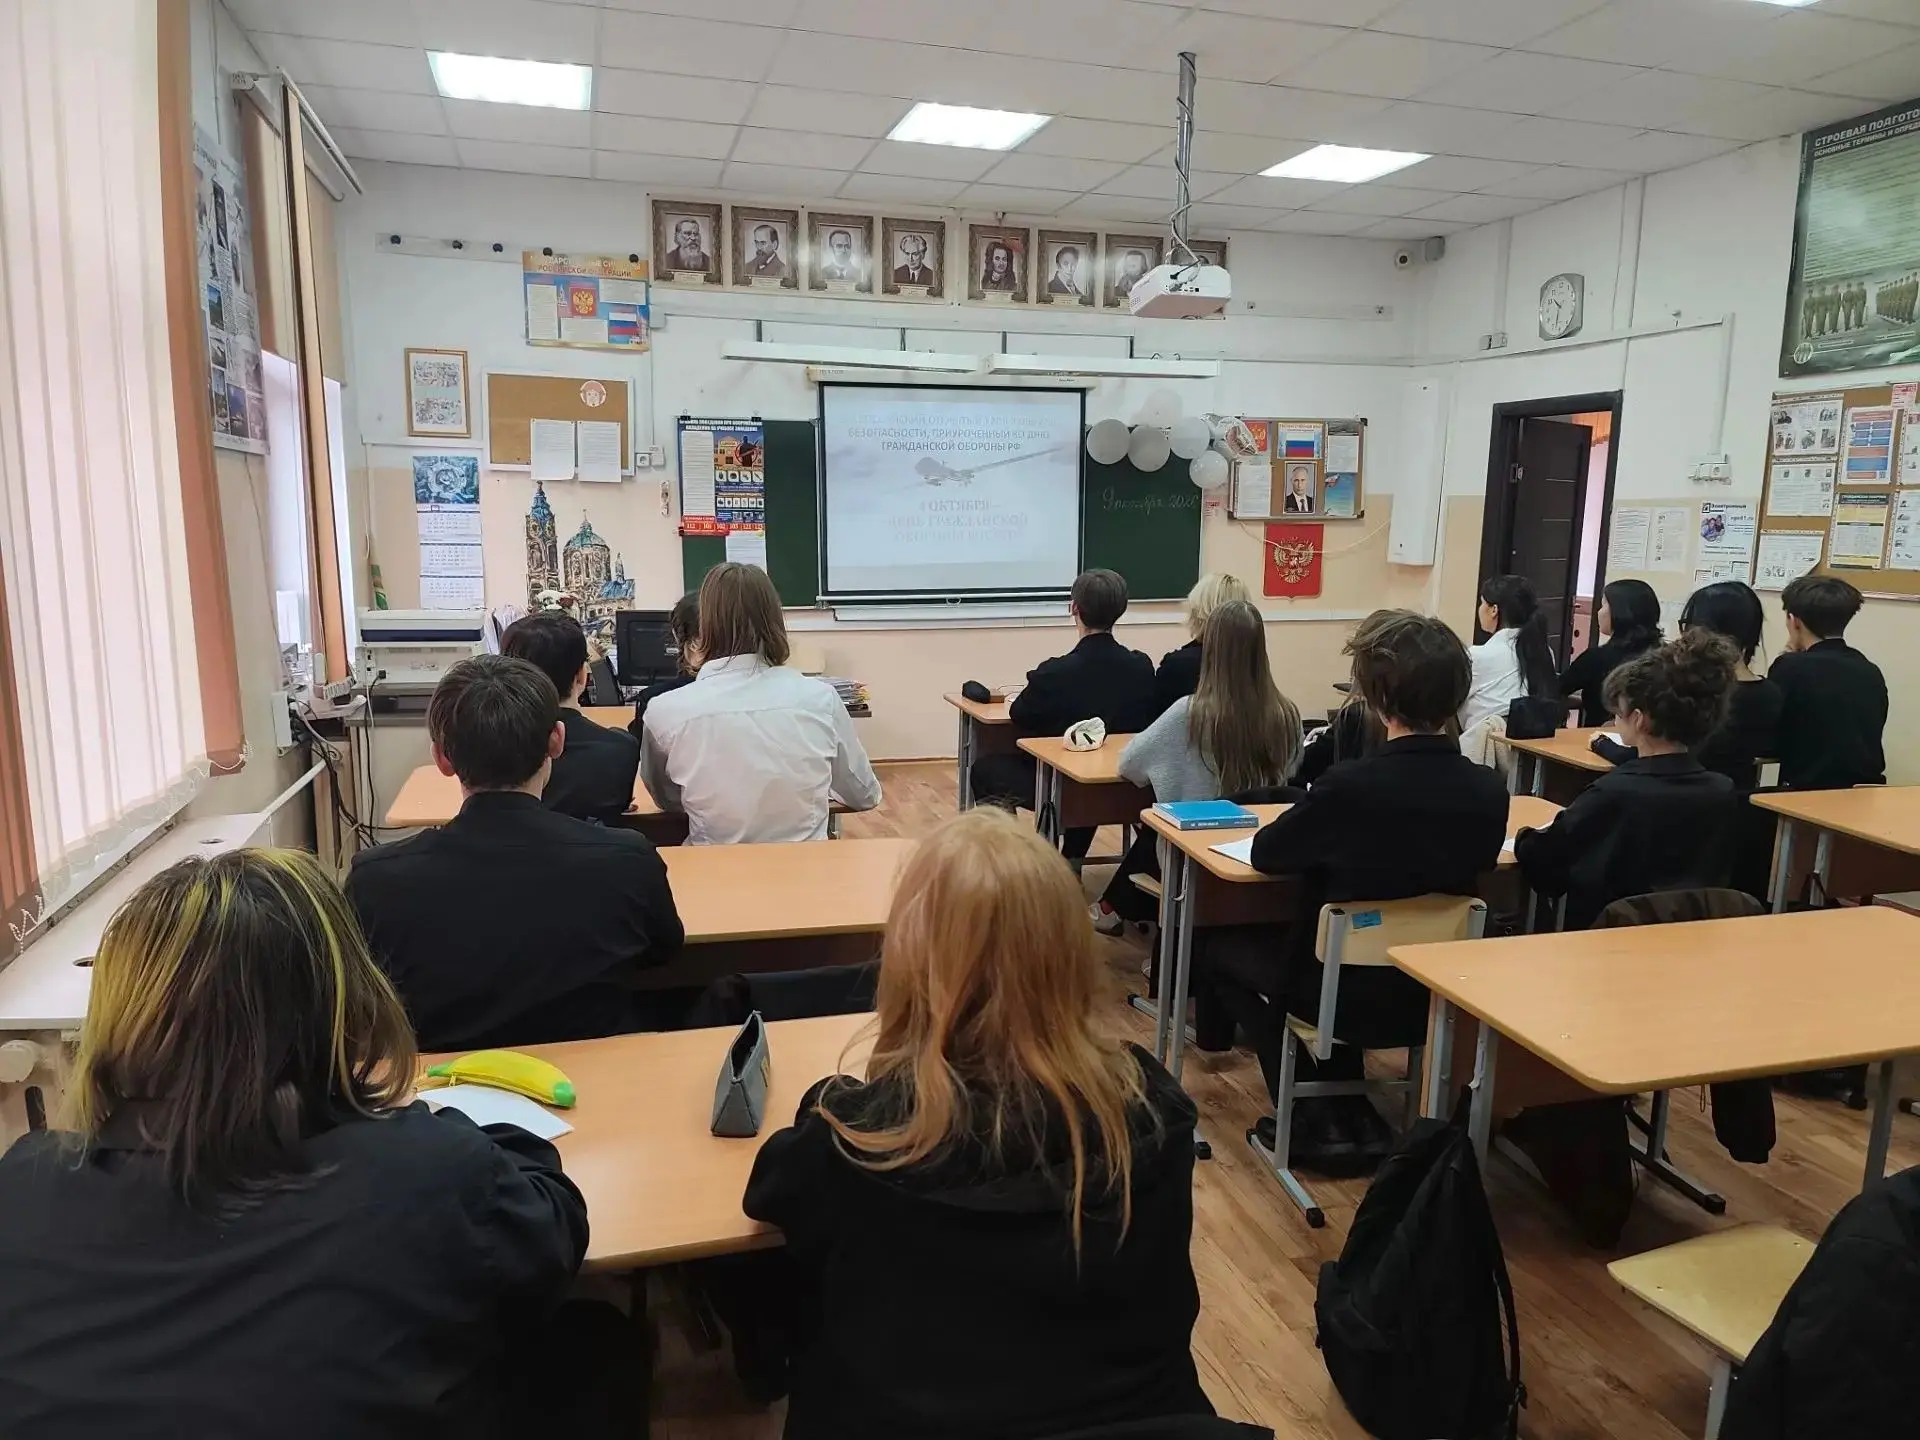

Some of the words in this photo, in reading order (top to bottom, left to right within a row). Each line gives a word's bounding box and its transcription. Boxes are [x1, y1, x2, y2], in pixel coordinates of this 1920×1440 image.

[1815, 125, 1867, 147] СТРОЕВАЯ
[1814, 141, 1851, 157] ОСНОВНЫЕ
[932, 428, 1010, 439] ПРИУРОЧЕННЫЙ
[881, 440, 955, 452] ГРАЖДАНСКОЙ
[957, 441, 1006, 452] ОБОРОНЫ
[1007, 442, 1022, 452] РФ
[928, 499, 990, 512] ОКТЯБРЯ
